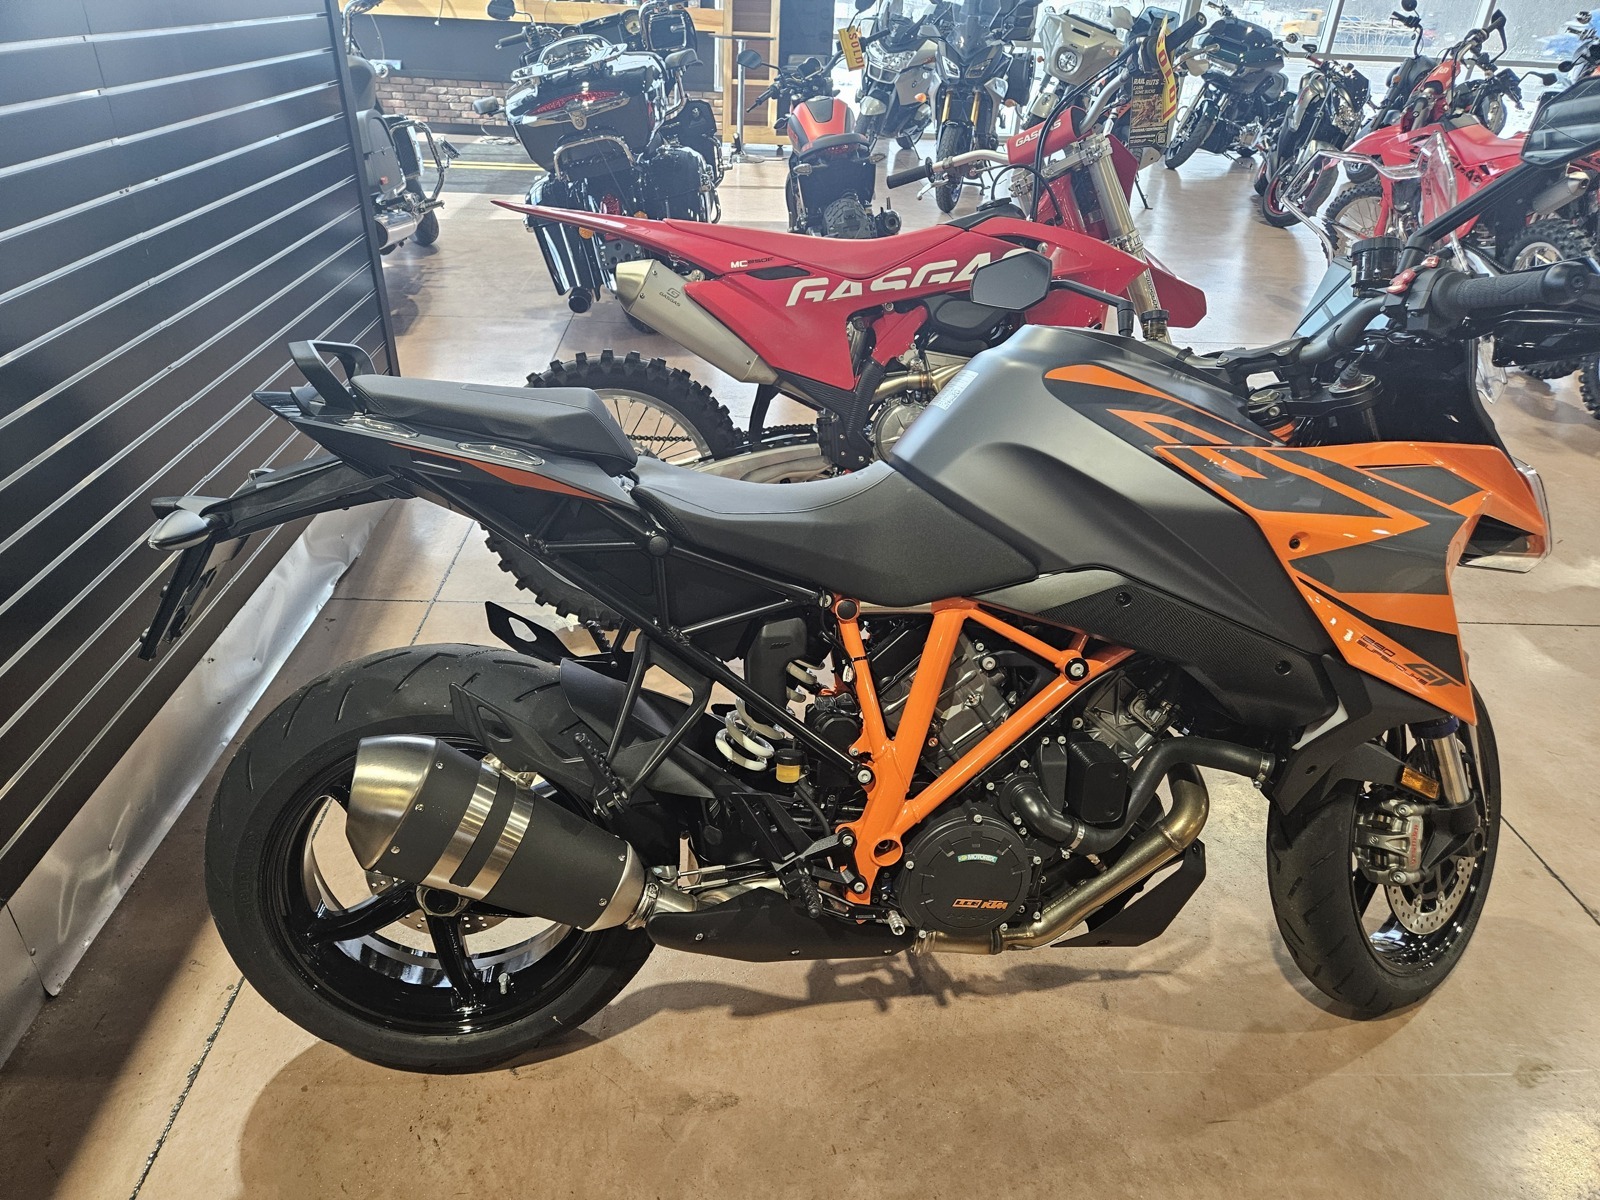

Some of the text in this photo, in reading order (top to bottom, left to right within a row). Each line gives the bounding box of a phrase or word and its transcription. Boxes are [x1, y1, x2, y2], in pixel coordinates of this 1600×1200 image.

[849, 33, 863, 64] SOLD
[1015, 119, 1061, 147] GASS
[785, 248, 1031, 307] GASGA
[1403, 663, 1462, 688] GT
[981, 900, 1008, 910] KTM
